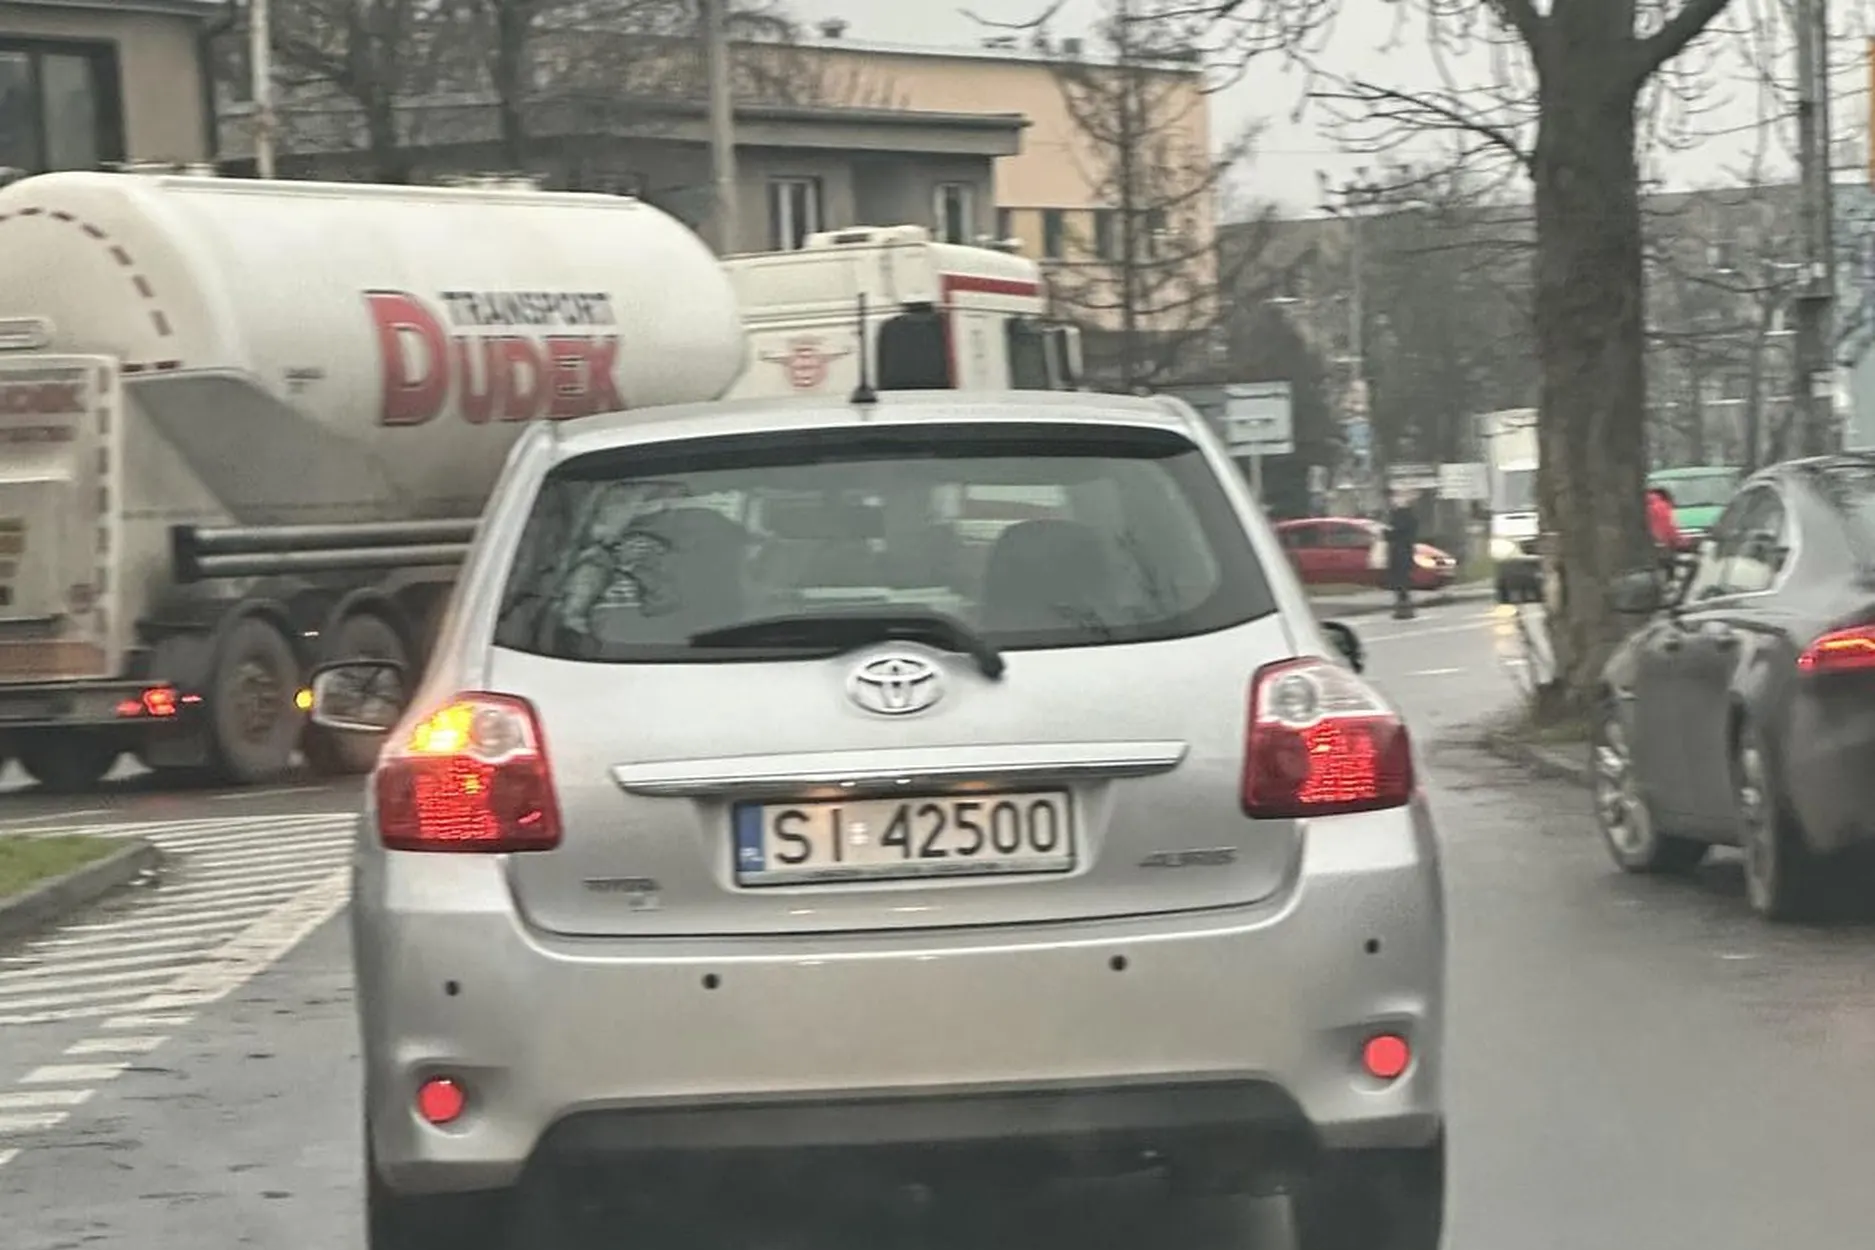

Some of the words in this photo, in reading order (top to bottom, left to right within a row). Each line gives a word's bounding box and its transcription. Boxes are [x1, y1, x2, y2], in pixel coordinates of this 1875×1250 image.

[441, 290, 613, 325] TRANSPORT
[361, 288, 628, 427] DUDEK
[773, 808, 844, 864] SI
[880, 799, 1058, 859] 42500
